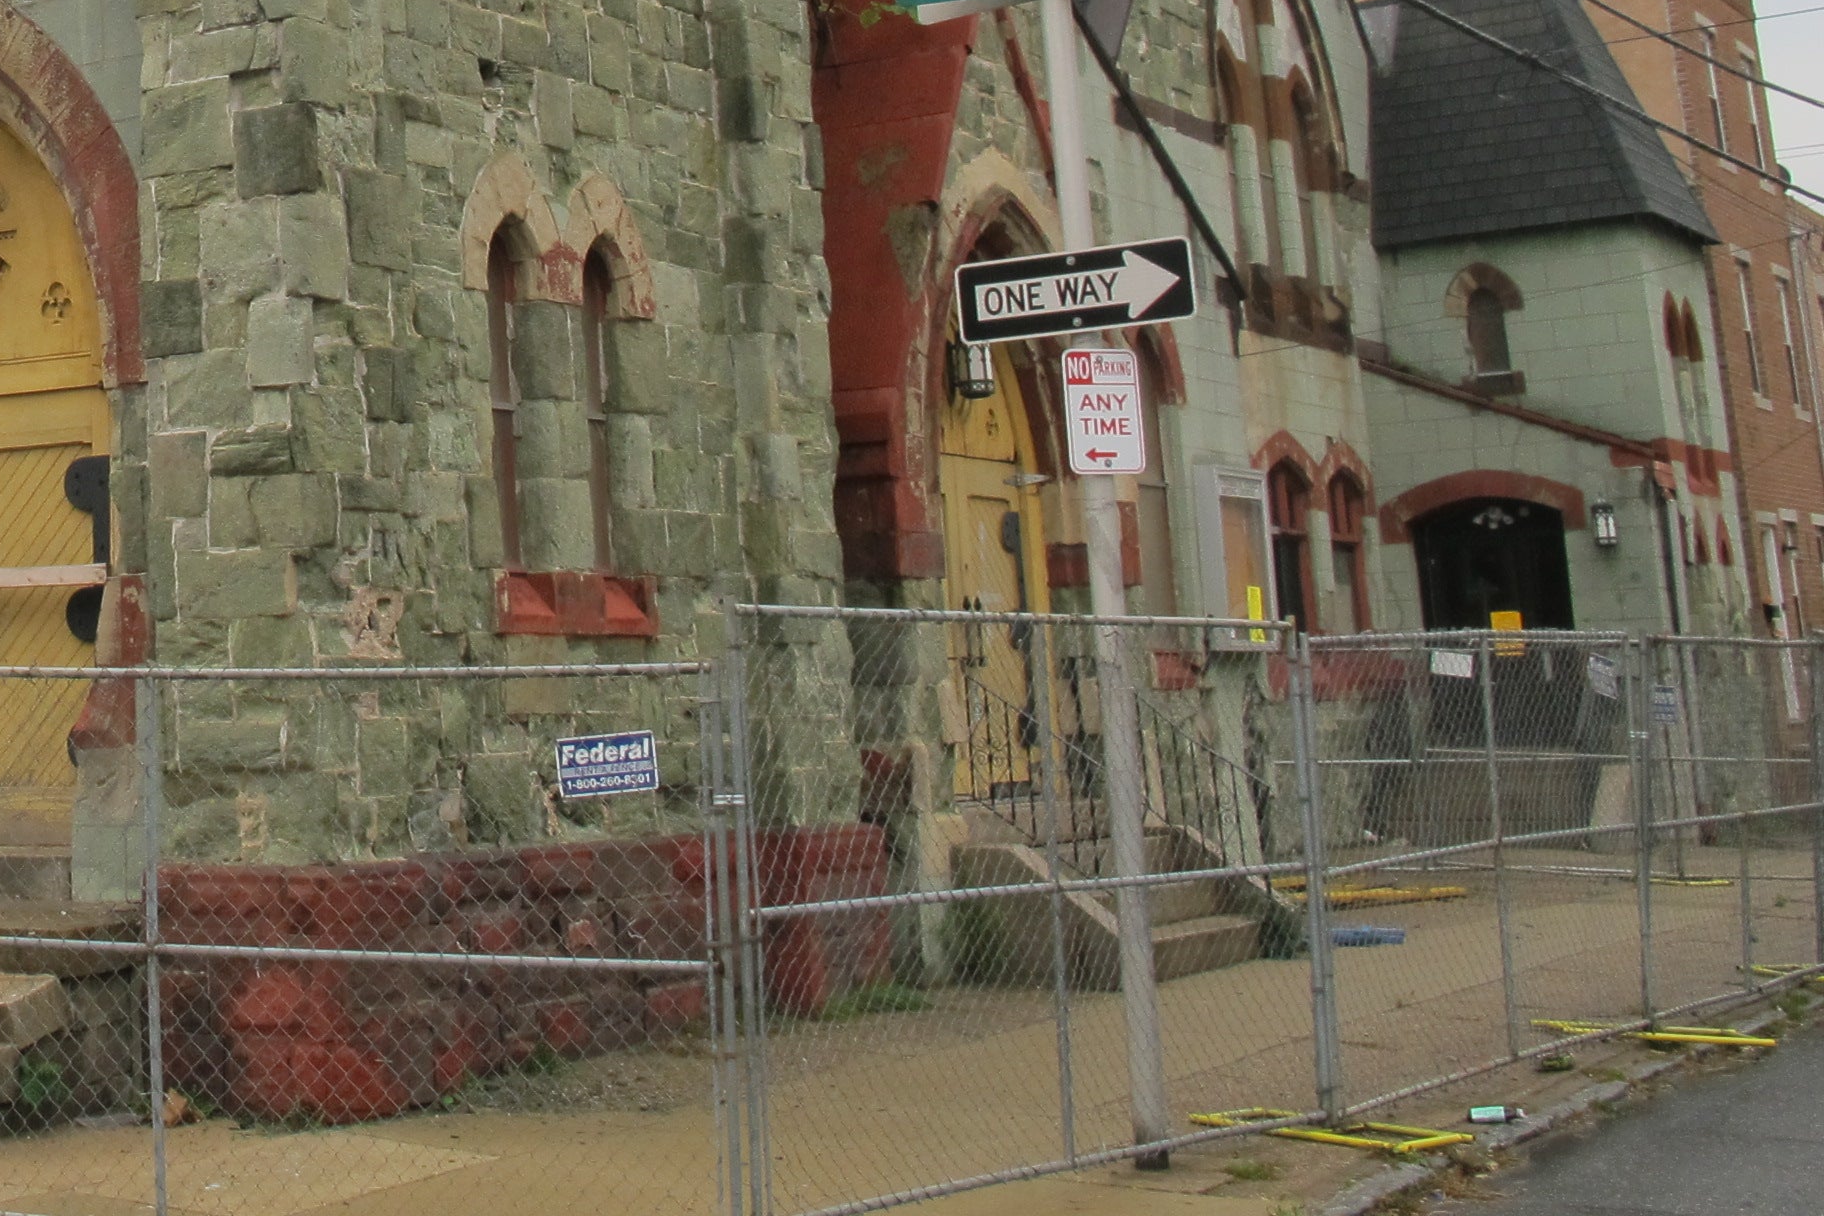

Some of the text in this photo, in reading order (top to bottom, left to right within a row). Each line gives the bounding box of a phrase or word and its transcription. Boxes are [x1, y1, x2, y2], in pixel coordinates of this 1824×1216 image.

[984, 271, 1119, 316] ONE WAY
[1067, 356, 1132, 379] NO PARKING
[1080, 393, 1129, 411] ANY
[1080, 417, 1132, 436] TIME
[562, 738, 650, 766] Federal
